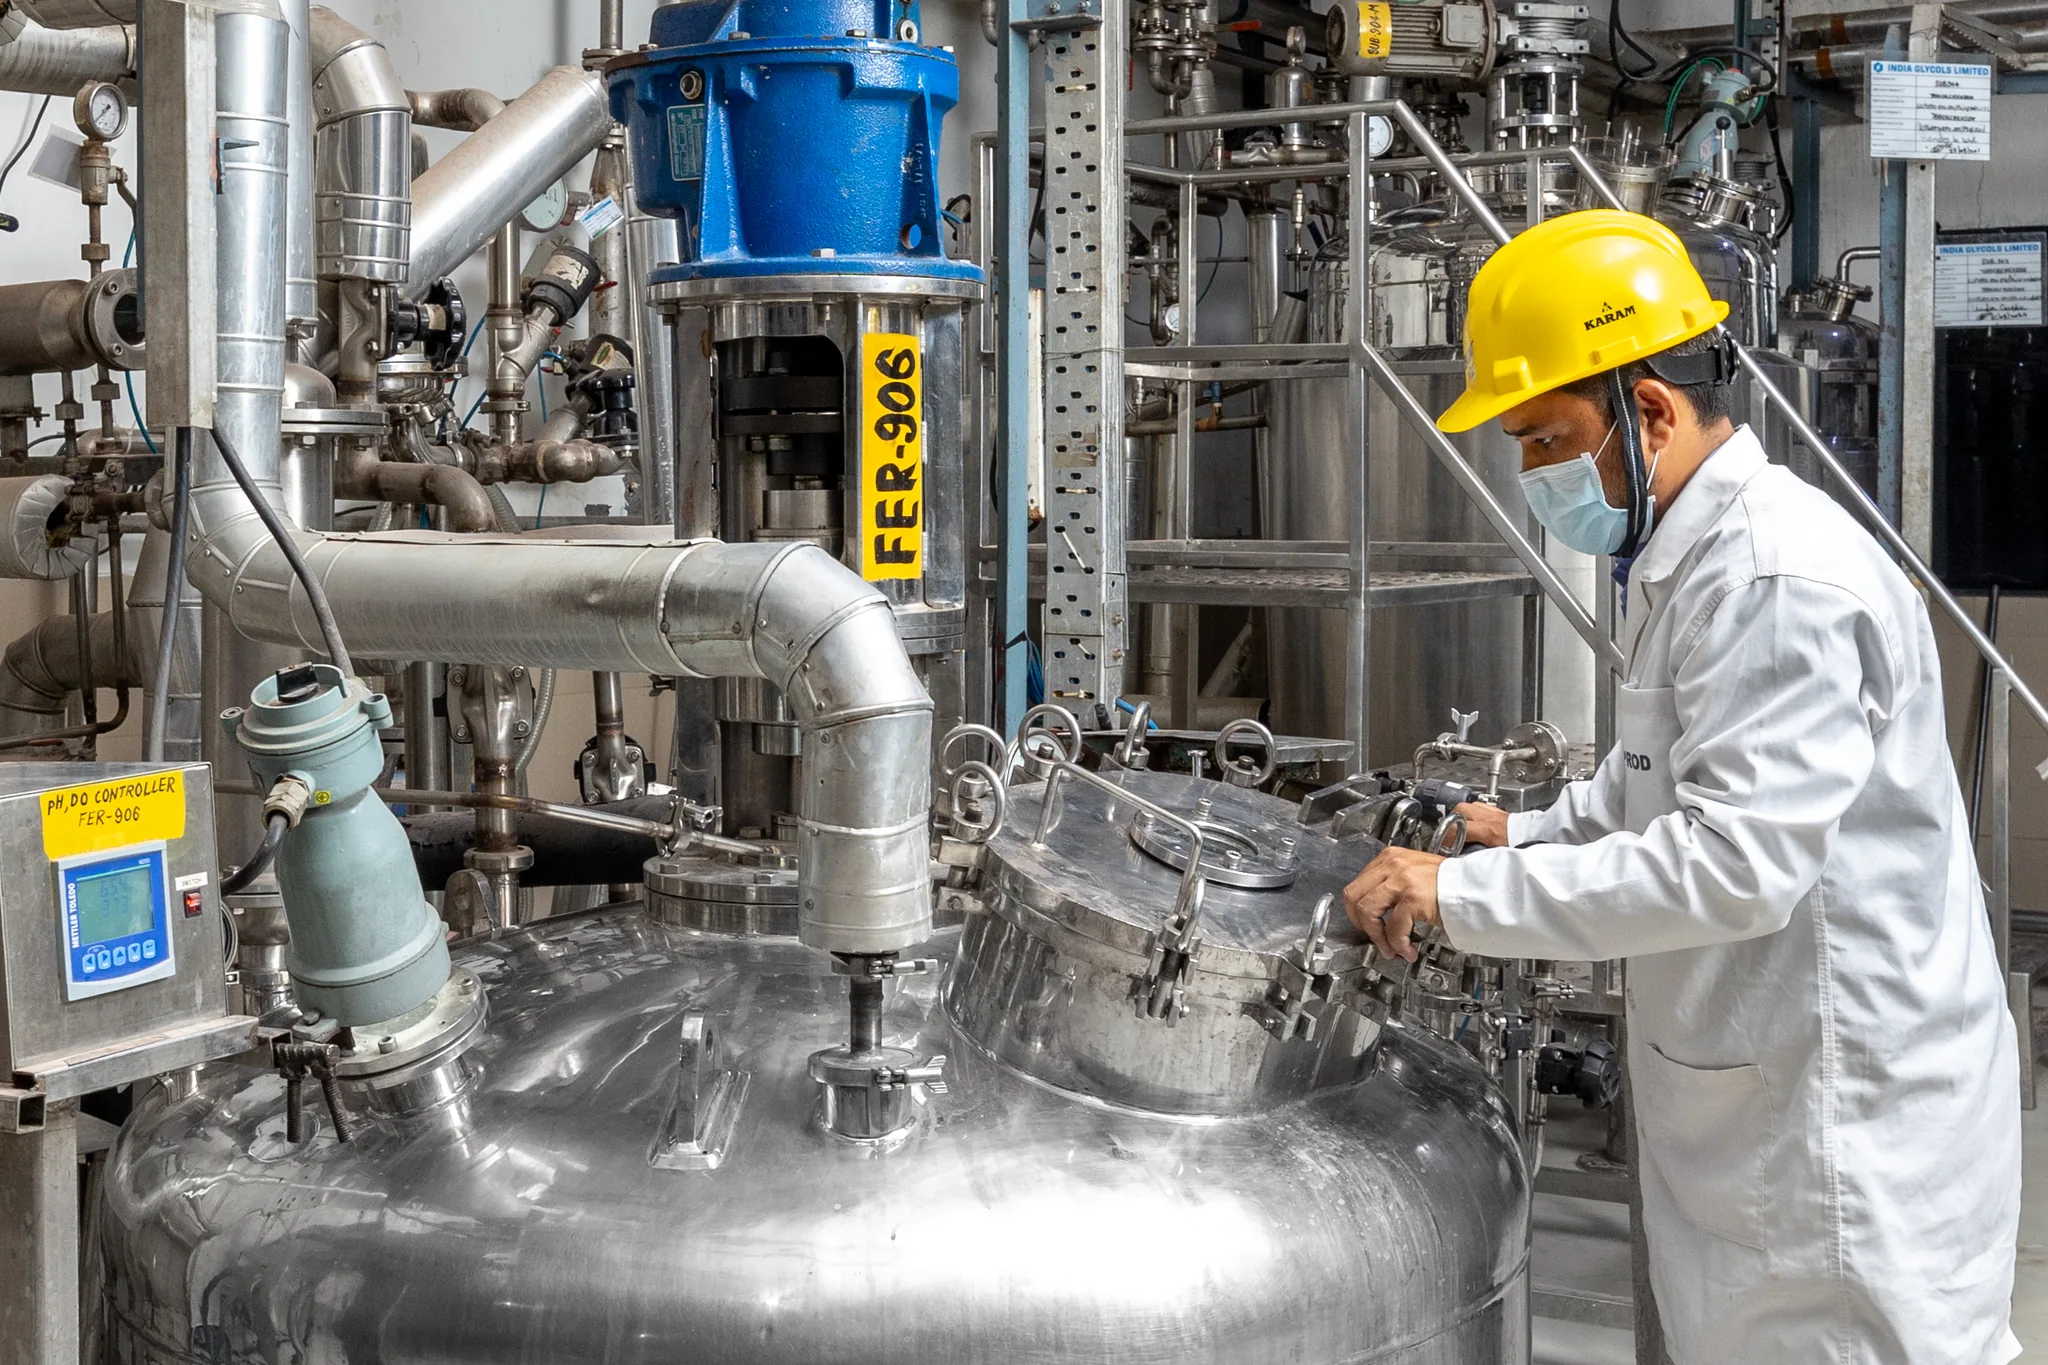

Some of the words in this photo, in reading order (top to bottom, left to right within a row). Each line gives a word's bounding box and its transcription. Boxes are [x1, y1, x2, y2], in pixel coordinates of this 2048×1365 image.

[1888, 64, 1912, 72] INDIA
[1914, 65, 1951, 74] GLYCOLS
[1954, 67, 1989, 75] LIMITED
[1940, 246, 1964, 254] INDIA
[1966, 245, 2002, 253] GLYCOLS
[2004, 244, 2039, 252] LIMITED
[1583, 305, 1636, 331] KARAM
[874, 347, 919, 564] FER-906
[95, 777, 175, 803] CONTROLLER
[78, 806, 140, 827] FER-906
[67, 883, 77, 913] TOLEDO
[70, 914, 80, 948] METTLER
